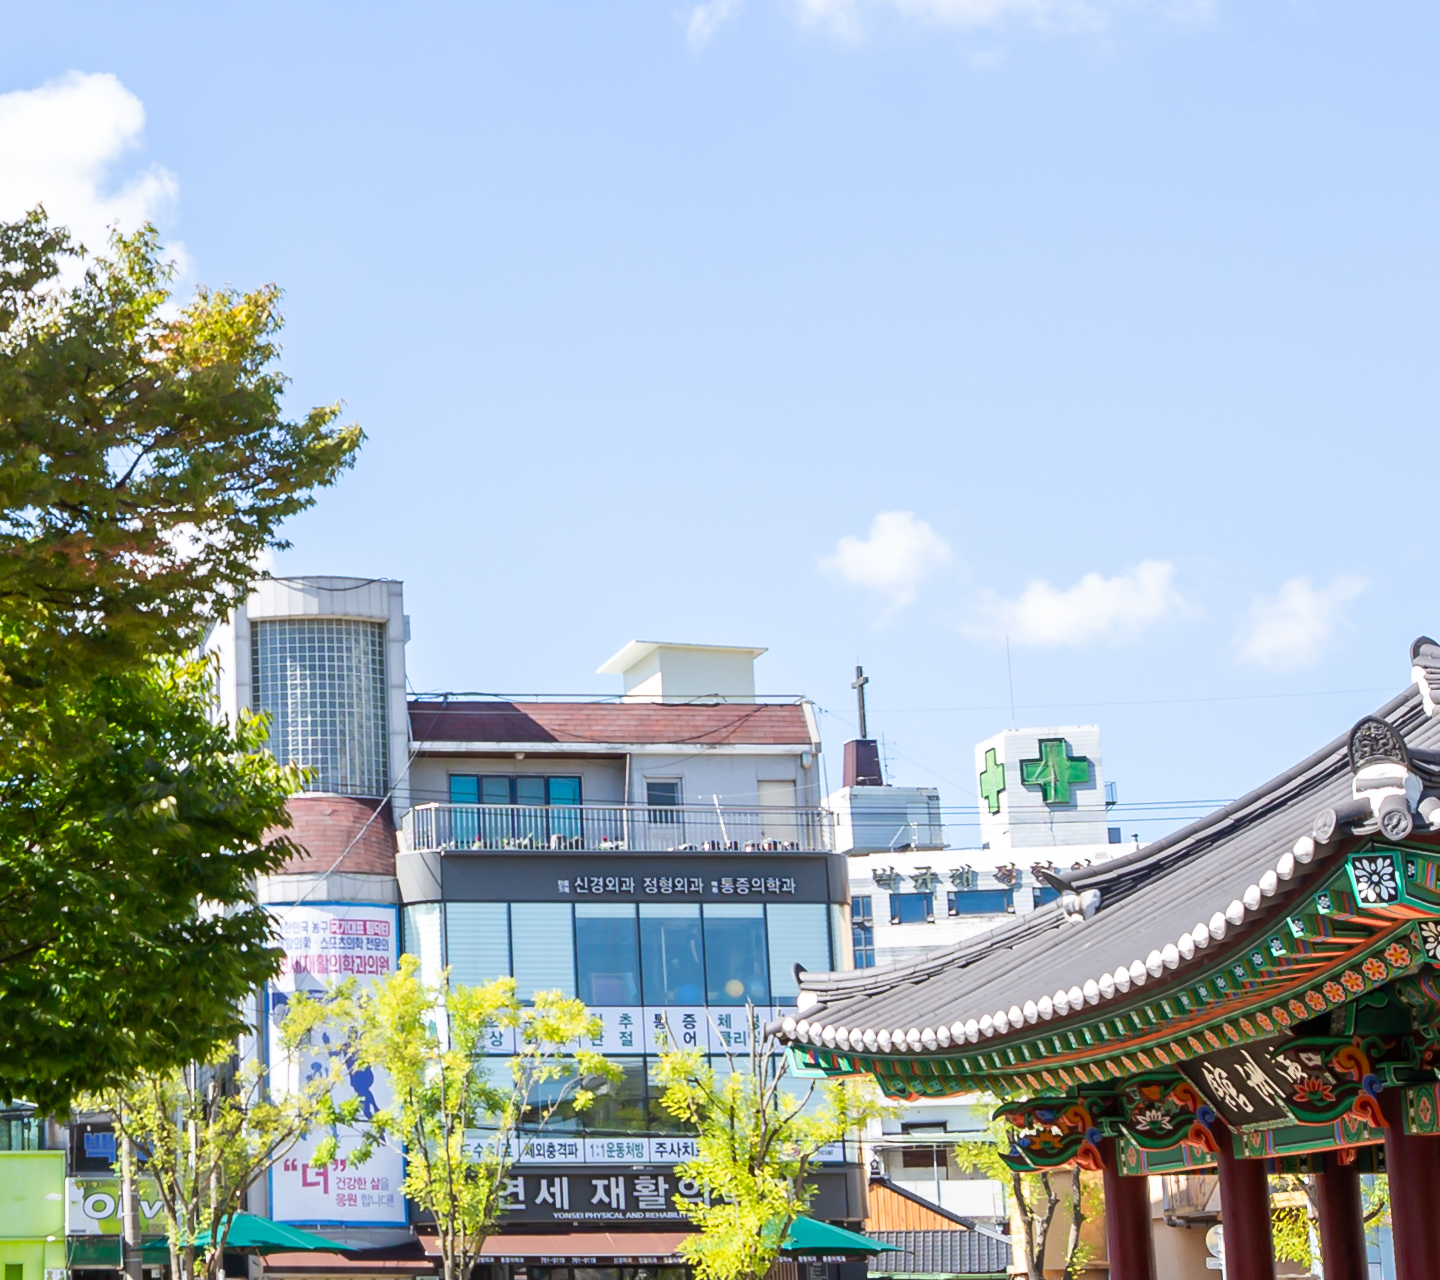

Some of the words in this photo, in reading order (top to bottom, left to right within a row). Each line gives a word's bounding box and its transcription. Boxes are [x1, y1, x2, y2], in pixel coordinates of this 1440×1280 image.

[574, 876, 636, 894] 신경외과
[643, 876, 704, 894] 정형외과
[720, 876, 796, 895] 통증의학과
[320, 937, 363, 950] 스포츠의학
[655, 1141, 699, 1157] 주사치
[336, 1177, 367, 1191] 건강한
[370, 1177, 389, 1191] 삶을
[336, 1193, 357, 1207] 응원
[584, 1211, 624, 1219] PHYSICAL
[625, 1211, 644, 1219] AND
